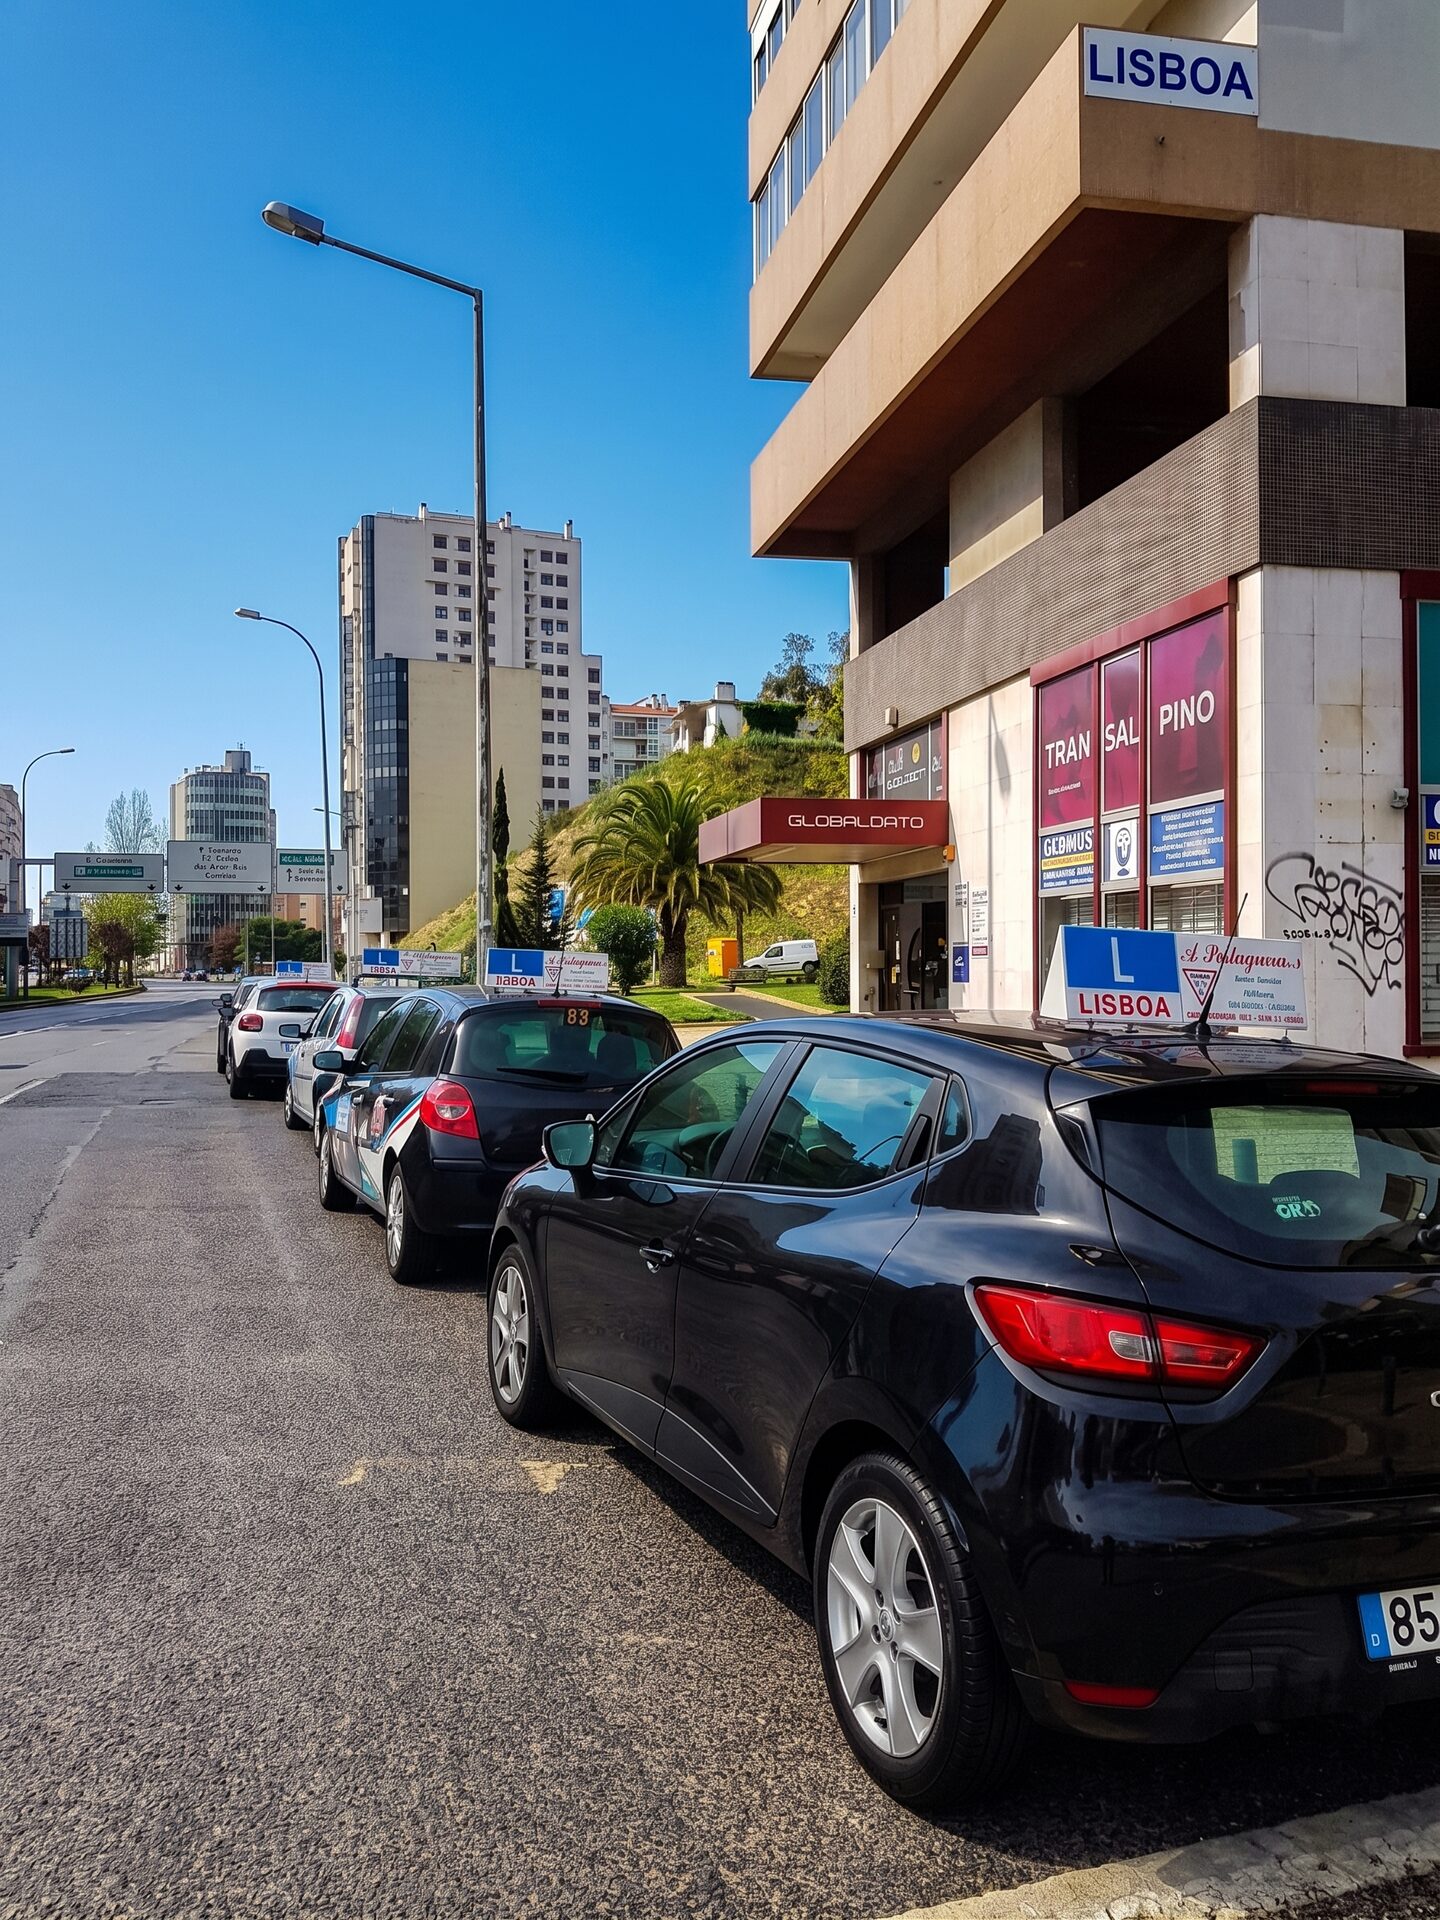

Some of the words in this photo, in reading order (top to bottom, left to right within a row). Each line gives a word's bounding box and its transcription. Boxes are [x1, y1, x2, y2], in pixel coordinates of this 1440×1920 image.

[1088, 43, 1254, 100] LISBOA
[1044, 729, 1091, 769] TRAN
[1104, 716, 1140, 752] SAL
[1159, 689, 1215, 736] PINO
[787, 814, 924, 829] GLOBALDATO
[378, 951, 388, 965] L
[511, 953, 523, 973] L
[1110, 935, 1135, 984] L
[567, 1008, 590, 1026] 83
[1078, 993, 1172, 1018] LISBOA
[1389, 1591, 1440, 1647] 85
